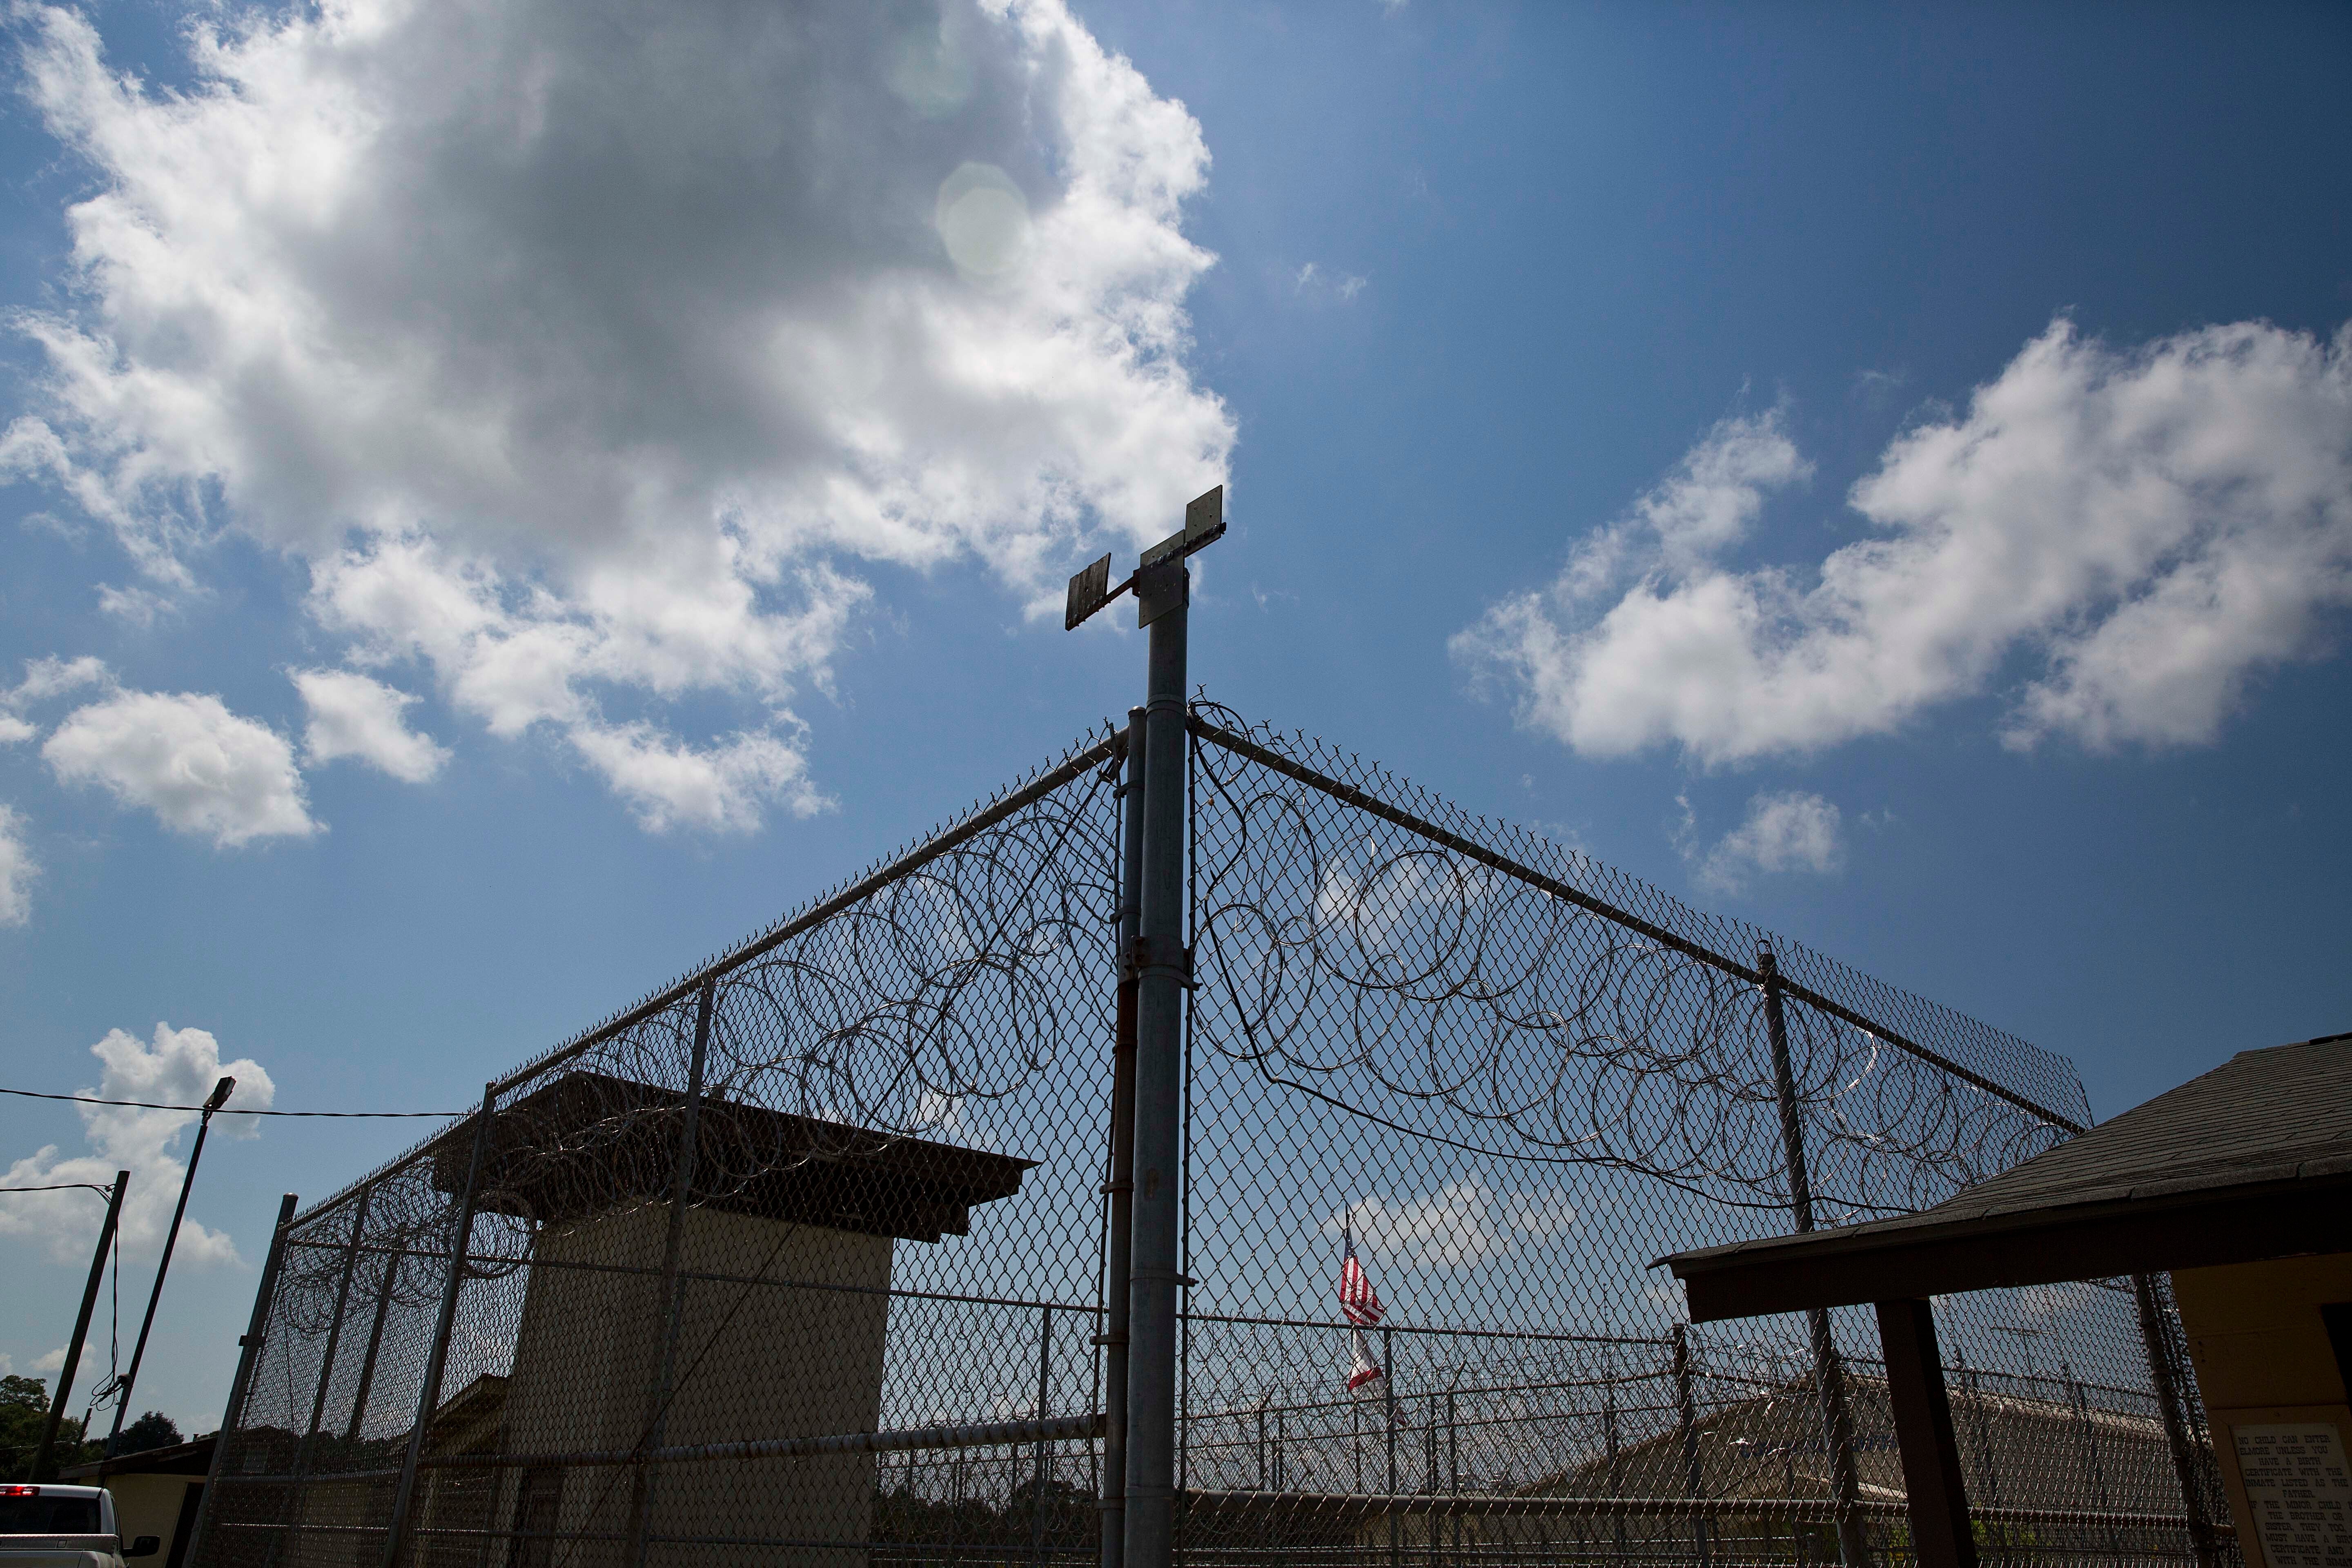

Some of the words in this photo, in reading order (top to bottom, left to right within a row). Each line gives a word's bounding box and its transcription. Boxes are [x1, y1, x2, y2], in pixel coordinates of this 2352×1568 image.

[2264, 1501, 2280, 1509] THE
[2319, 1501, 2341, 1509] CHILD
[2290, 1512, 2326, 1520] BROTHER
[2300, 1523, 2321, 1531] THEY
[2271, 1545, 2320, 1554] CERTIFICATE
[2328, 1546, 2344, 1555] AND
[2275, 1556, 2296, 1565] WITH
[2303, 1557, 2319, 1565] THE
